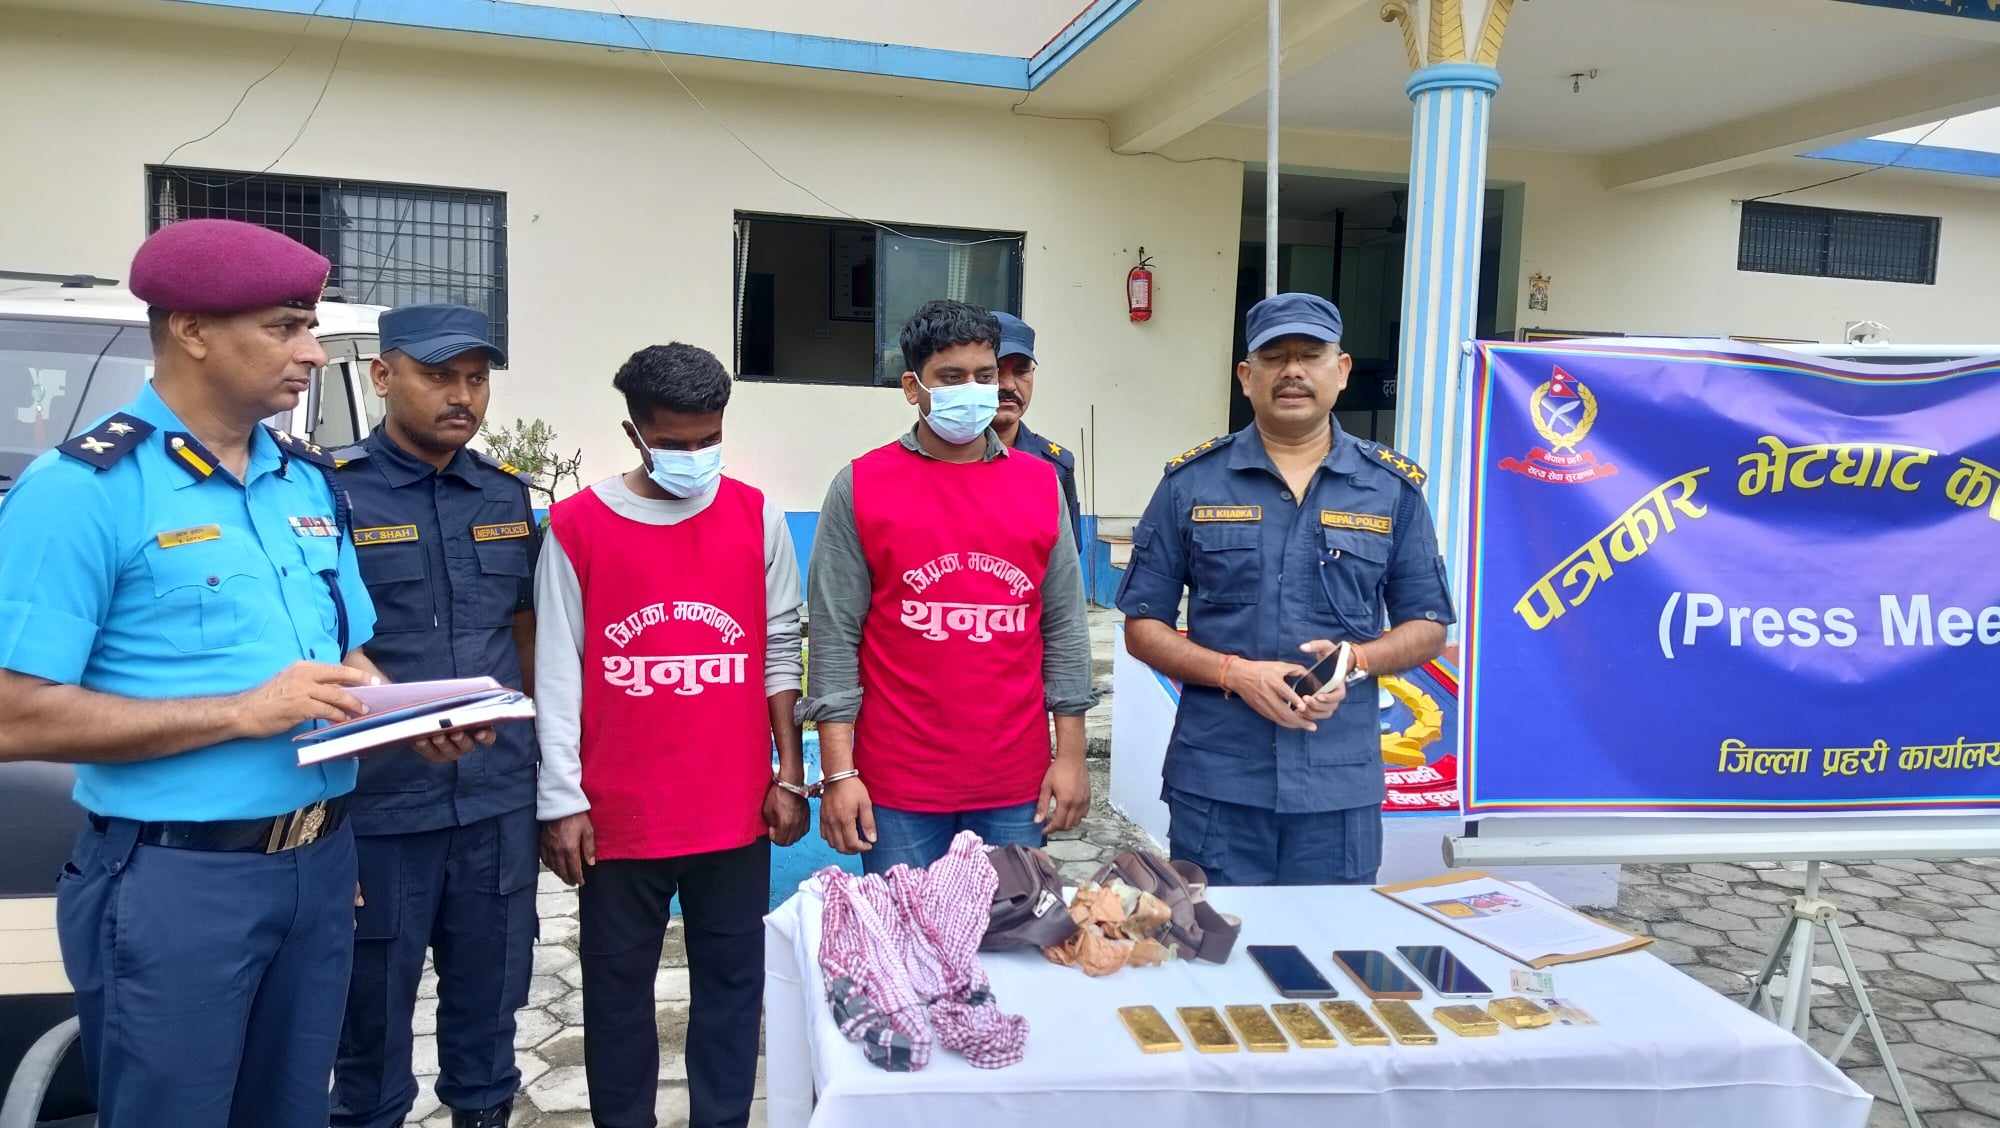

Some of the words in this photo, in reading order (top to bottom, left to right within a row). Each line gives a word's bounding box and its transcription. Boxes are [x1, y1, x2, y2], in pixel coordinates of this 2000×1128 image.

[380, 529, 410, 540] SHAH
[477, 527, 500, 538] NEPAL
[501, 525, 525, 536] POLICE
[1325, 513, 1355, 525] NEPAL
[1356, 517, 1388, 530] POLICE
[1513, 466, 1709, 631] पत्रकार
[1737, 436, 1938, 495] भेटघाट
[967, 552, 1035, 598] मकवानपुर
[673, 601, 746, 645] मकवानपुर
[901, 600, 1030, 643] थुनुवा
[1658, 592, 1858, 659] (Press
[1879, 594, 2000, 647] Mee
[602, 653, 748, 697] थुनुवा
[1718, 738, 1812, 775] जिल्ला
[1823, 739, 1890, 776] प्रहरी
